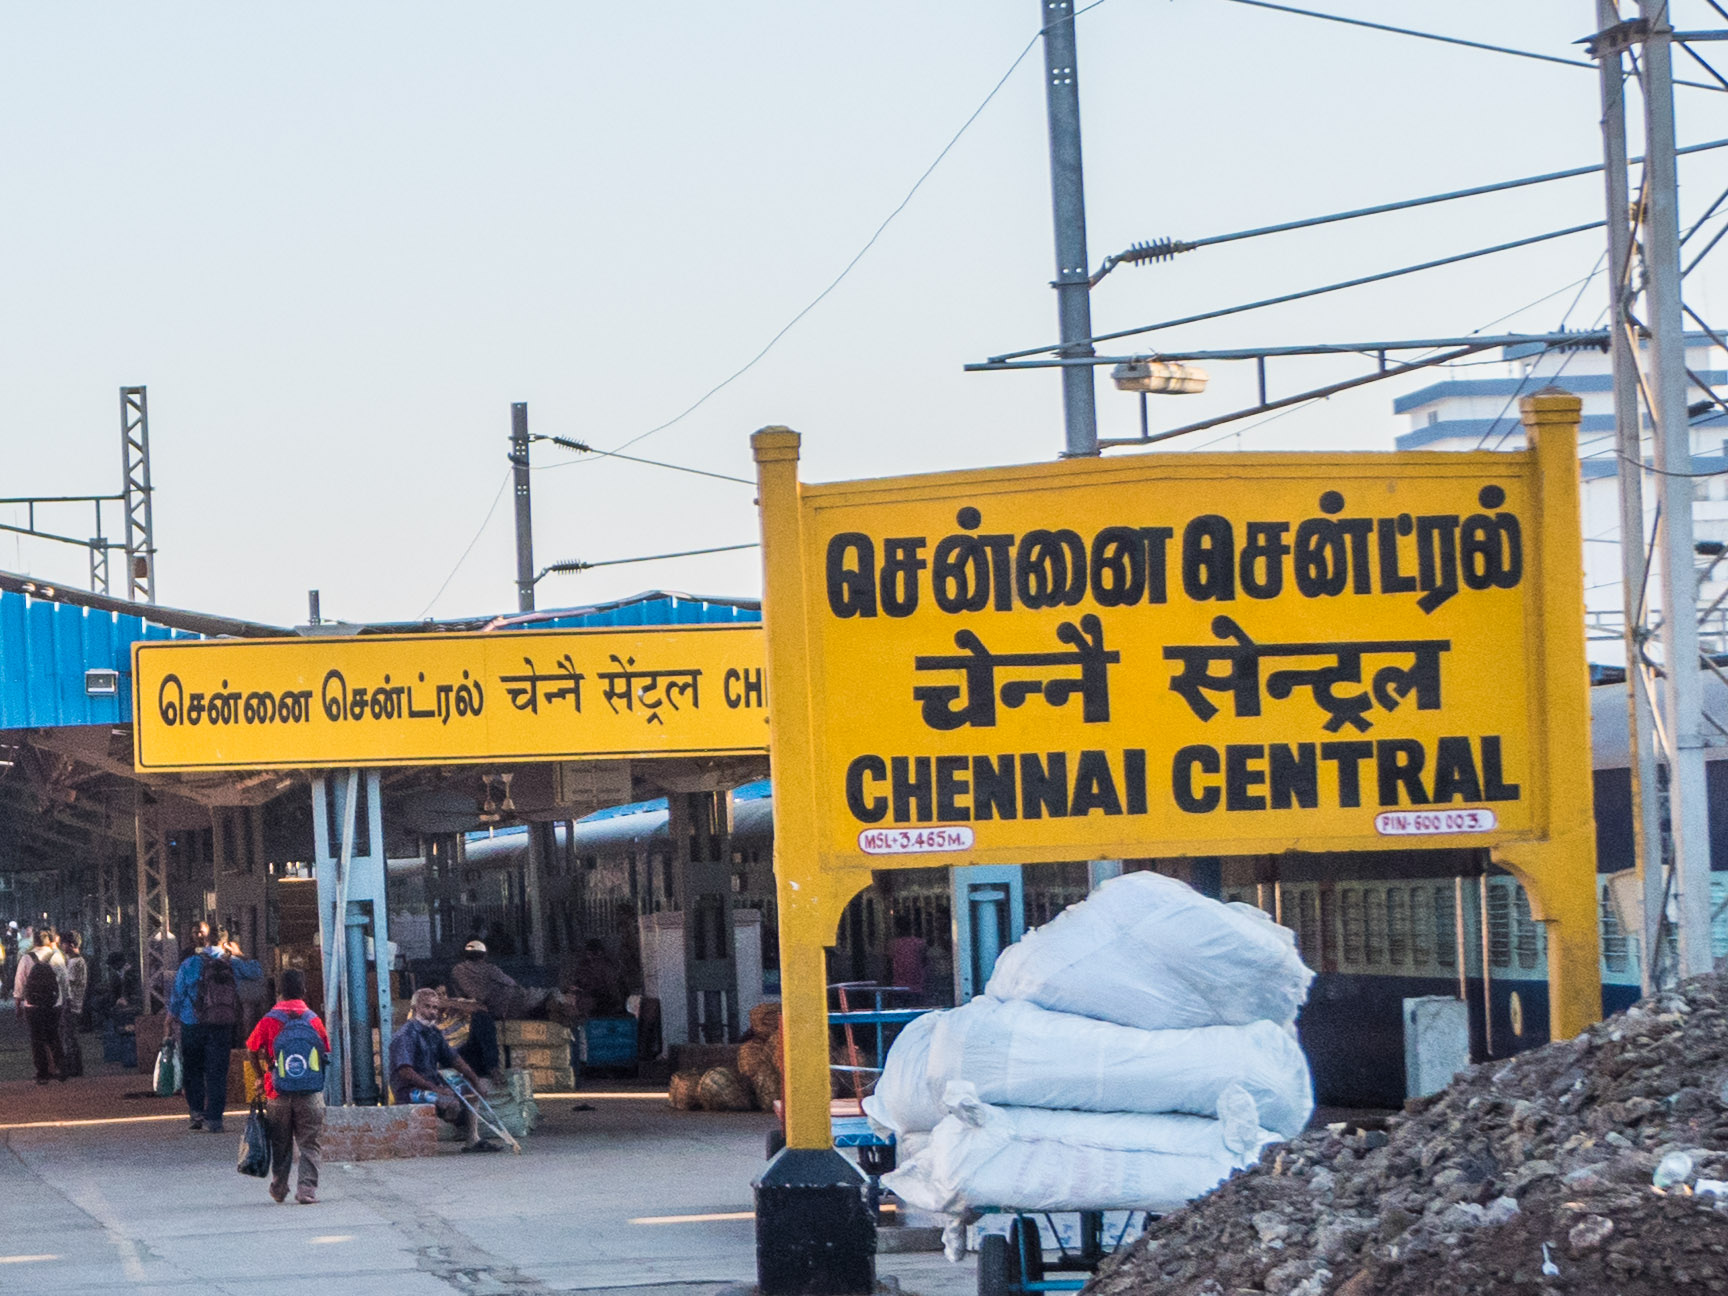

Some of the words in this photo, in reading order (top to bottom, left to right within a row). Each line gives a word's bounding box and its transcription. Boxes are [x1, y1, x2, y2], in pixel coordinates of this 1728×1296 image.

[826, 507, 1173, 619] சென்னை
[159, 674, 312, 726] சென்னை
[500, 655, 585, 714] चेन्नै
[597, 655, 702, 724] सेंट्रल
[724, 668, 768, 709] CH
[914, 614, 1120, 730] चेन्नै
[1163, 615, 1451, 733] सेन्ट्रल
[846, 749, 1147, 823] CHENNAI
[1172, 736, 1520, 814] CENTRAL
